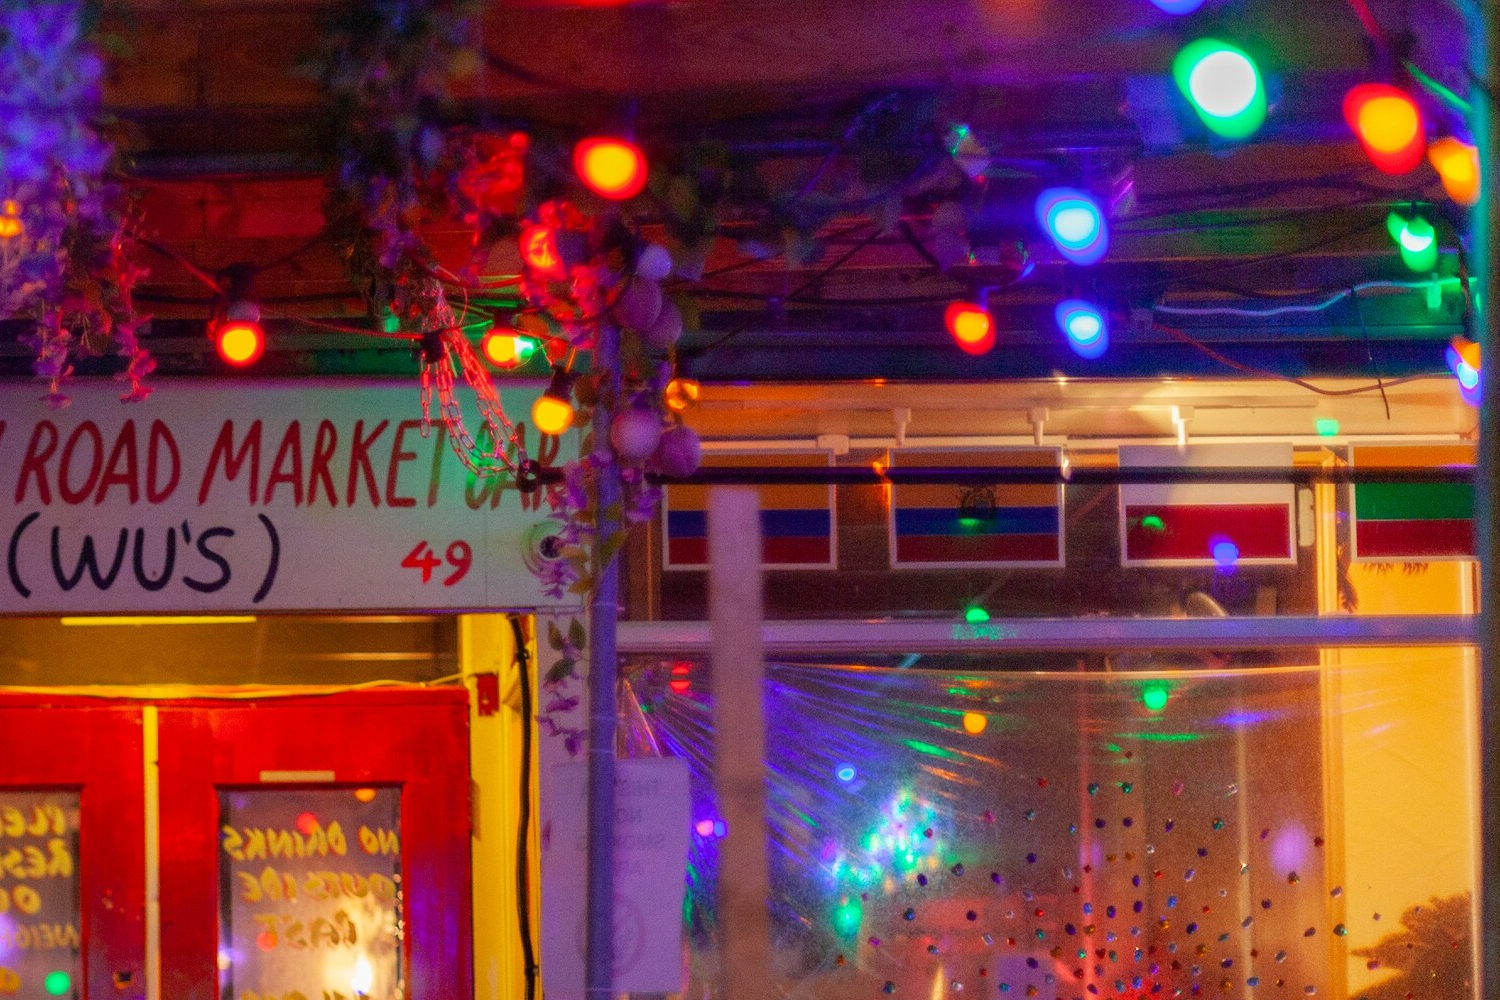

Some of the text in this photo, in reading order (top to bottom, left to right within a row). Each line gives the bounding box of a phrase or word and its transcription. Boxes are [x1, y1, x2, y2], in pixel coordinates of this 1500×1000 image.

[15, 418, 182, 507] ROAD
[198, 418, 449, 510] MARKET
[400, 539, 472, 587] 49
